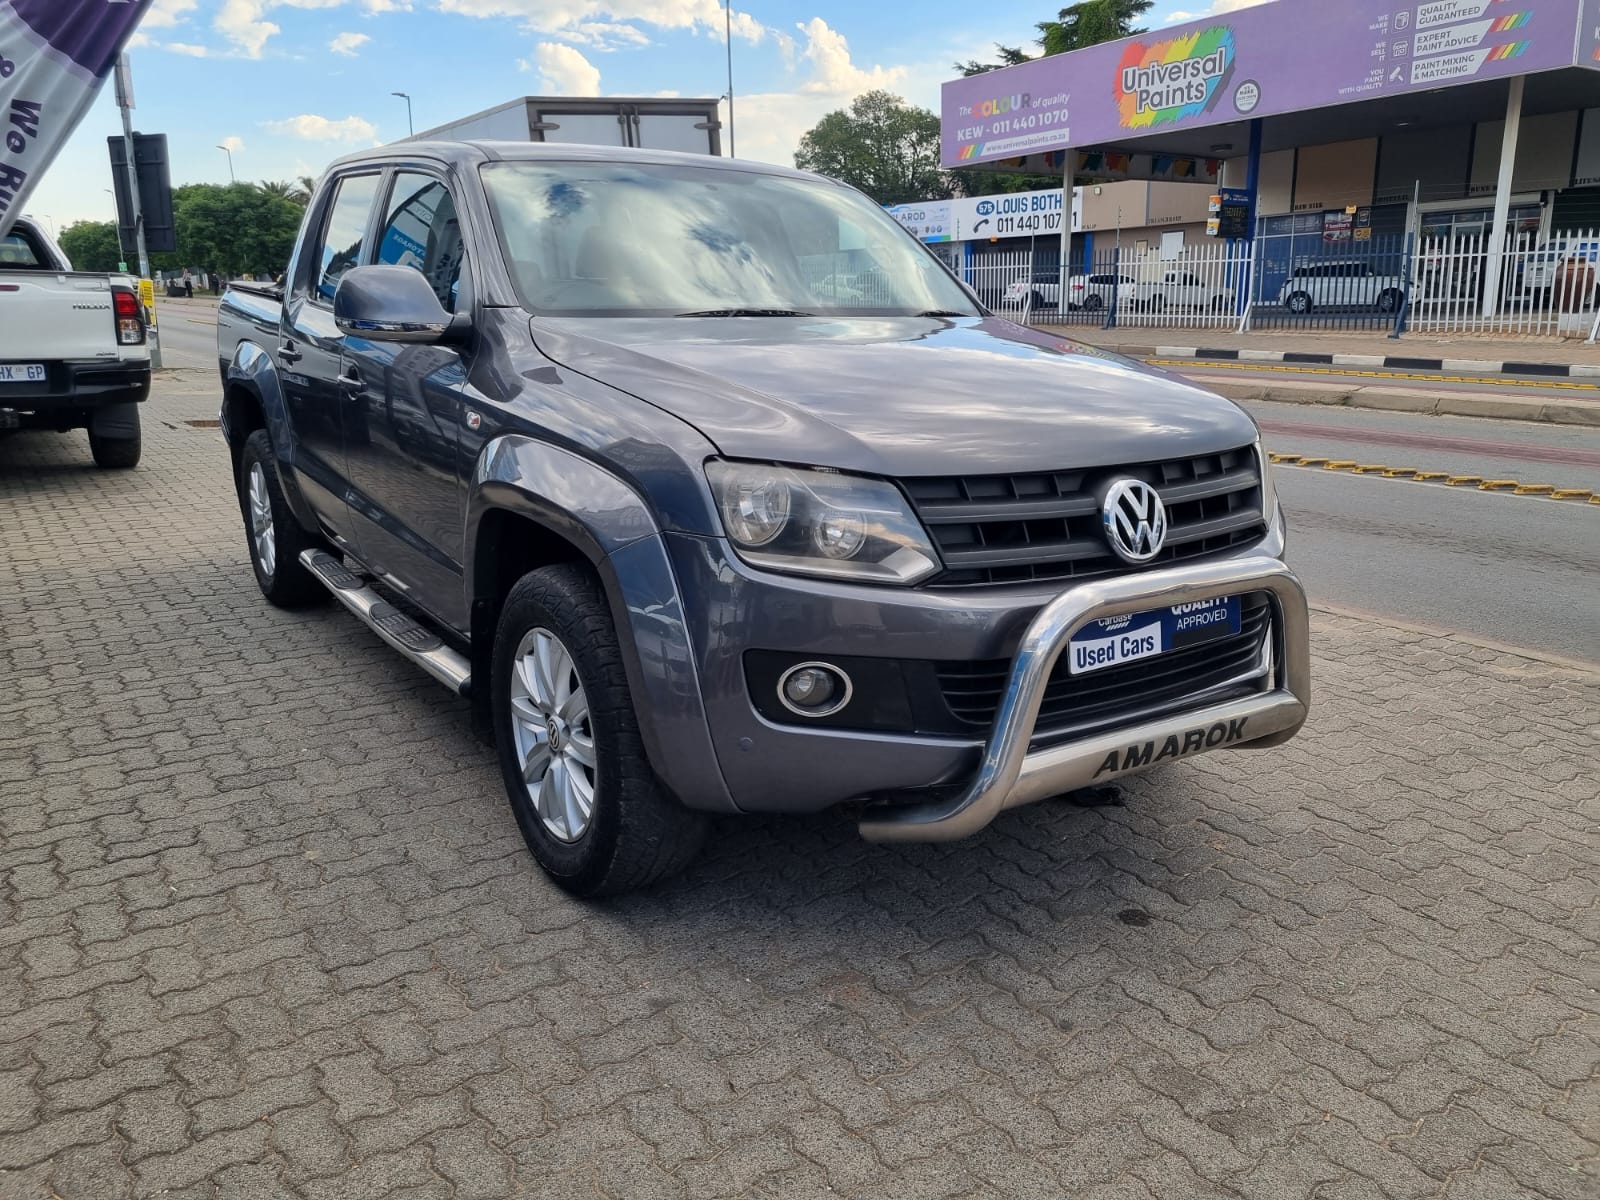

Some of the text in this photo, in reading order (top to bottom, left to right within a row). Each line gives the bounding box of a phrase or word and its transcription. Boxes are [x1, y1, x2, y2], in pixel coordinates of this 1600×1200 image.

[1419, 6, 1481, 25] GUARANTEED
[1420, 2, 1458, 17] QUALITY
[1416, 34, 1479, 53] PAINT ADVICE
[1417, 30, 1452, 44] EXPERT
[1371, 48, 1386, 57] SELL
[1124, 49, 1224, 92] Universal
[1370, 68, 1384, 76] YOU
[1414, 54, 1475, 72] PAINT MIXING
[1414, 64, 1468, 80] & MATCHING
[1364, 74, 1384, 83] PAINT
[1138, 80, 1205, 111] Paints
[1338, 82, 1383, 95] WITH QUALITY
[959, 92, 1071, 119] The COLOUR of quality
[7, 98, 42, 154] We
[957, 126, 984, 142] KEW
[992, 120, 1010, 135] 011
[1013, 115, 1036, 130] 440
[1038, 108, 1069, 126] 1070
[979, 193, 1063, 215] 575 LOUIS BOTH
[997, 217, 1014, 233] 011
[1016, 214, 1040, 231] 440
[1042, 211, 1077, 230] 1071
[27, 366, 43, 379] GP
[1176, 608, 1228, 631] APPROVED
[1076, 634, 1155, 669] Used Cars
[1091, 716, 1249, 780] AMAROK
